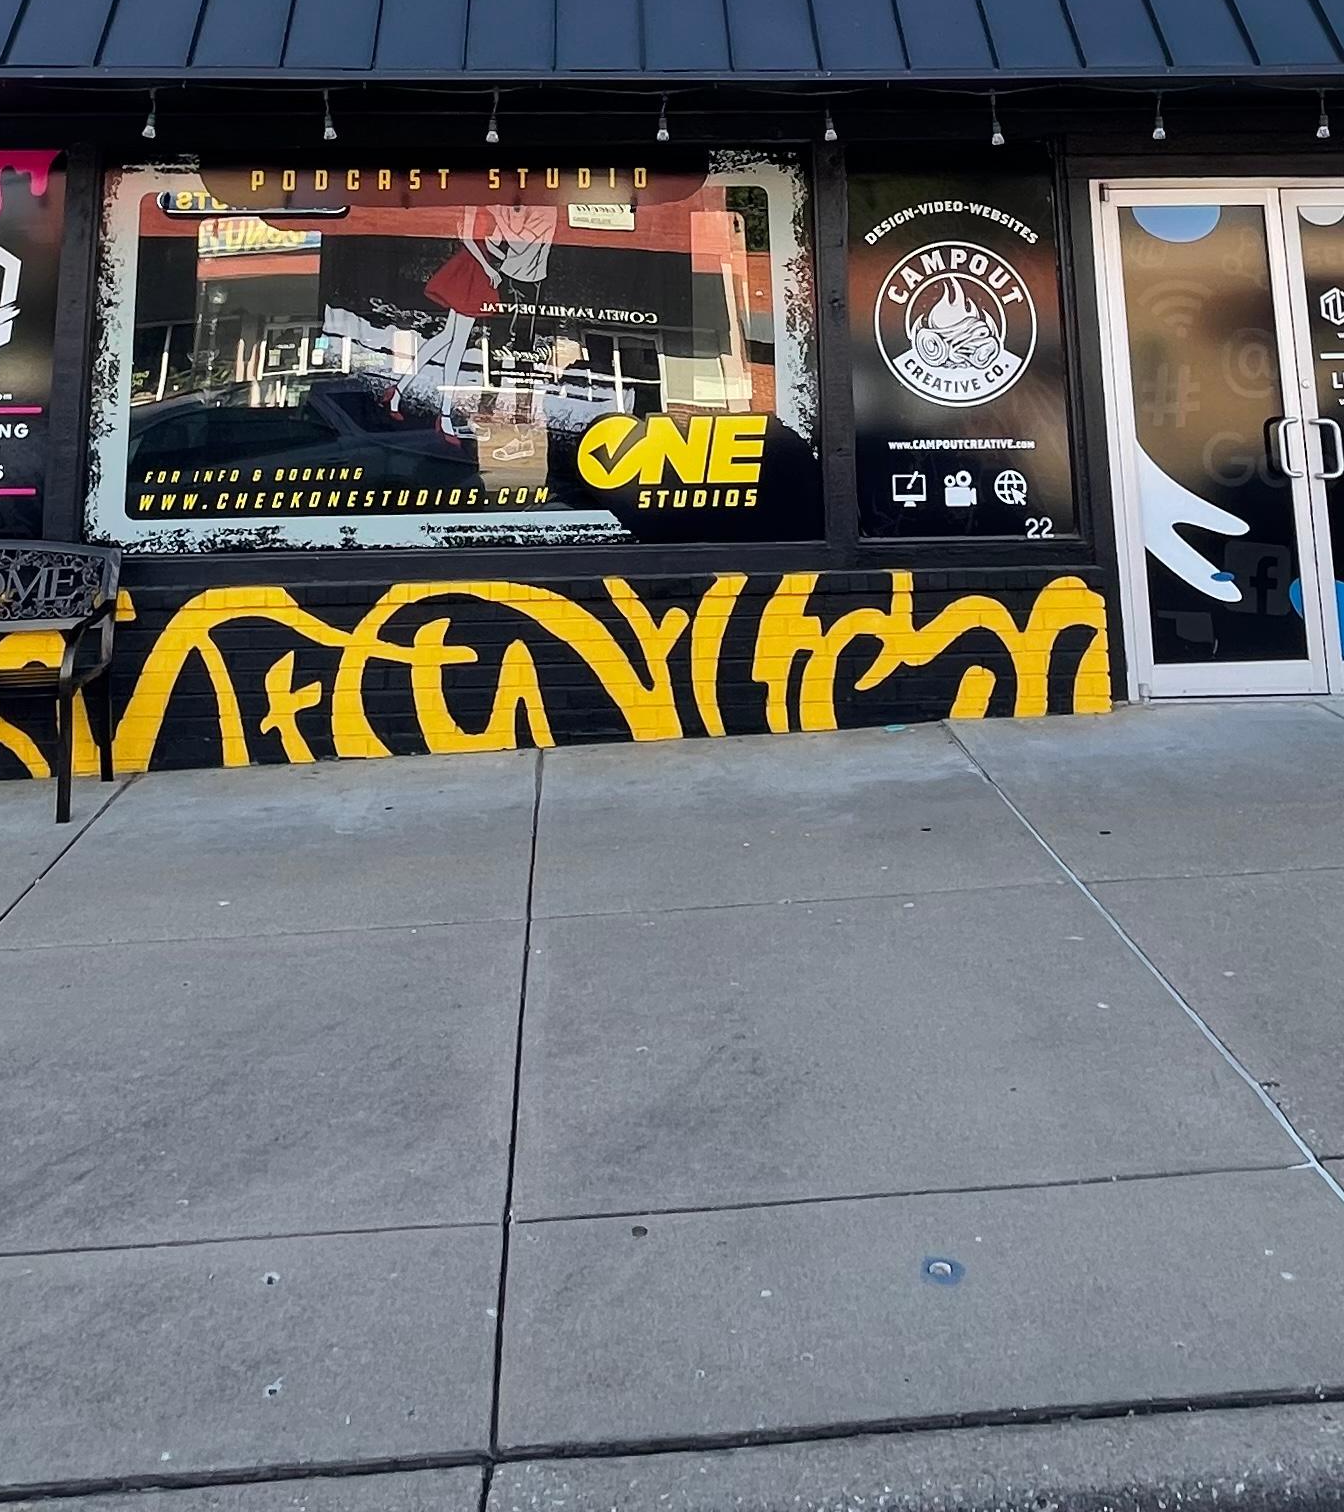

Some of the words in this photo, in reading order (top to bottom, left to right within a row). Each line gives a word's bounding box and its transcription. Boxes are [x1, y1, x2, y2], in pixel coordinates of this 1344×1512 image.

[250, 168, 452, 192] PODCAST
[489, 166, 648, 190] STUDIO
[864, 200, 1039, 246] DESIGN-VIDEO-WEBSITES
[887, 249, 1024, 306] CAMPOUT
[903, 358, 981, 394] CREATIVE
[984, 362, 1010, 383] CO.
[578, 415, 769, 489] ONE
[888, 438, 1035, 451] www.CAMPOUTCREATIVE.com
[144, 470, 182, 485] FOR
[192, 469, 240, 483] INFO
[275, 467, 365, 483] BOOKING
[138, 486, 549, 513] WWW.CHECKONESTUDIOS.COM
[638, 489, 758, 509] STUDIOS
[1025, 517, 1055, 539] 22
